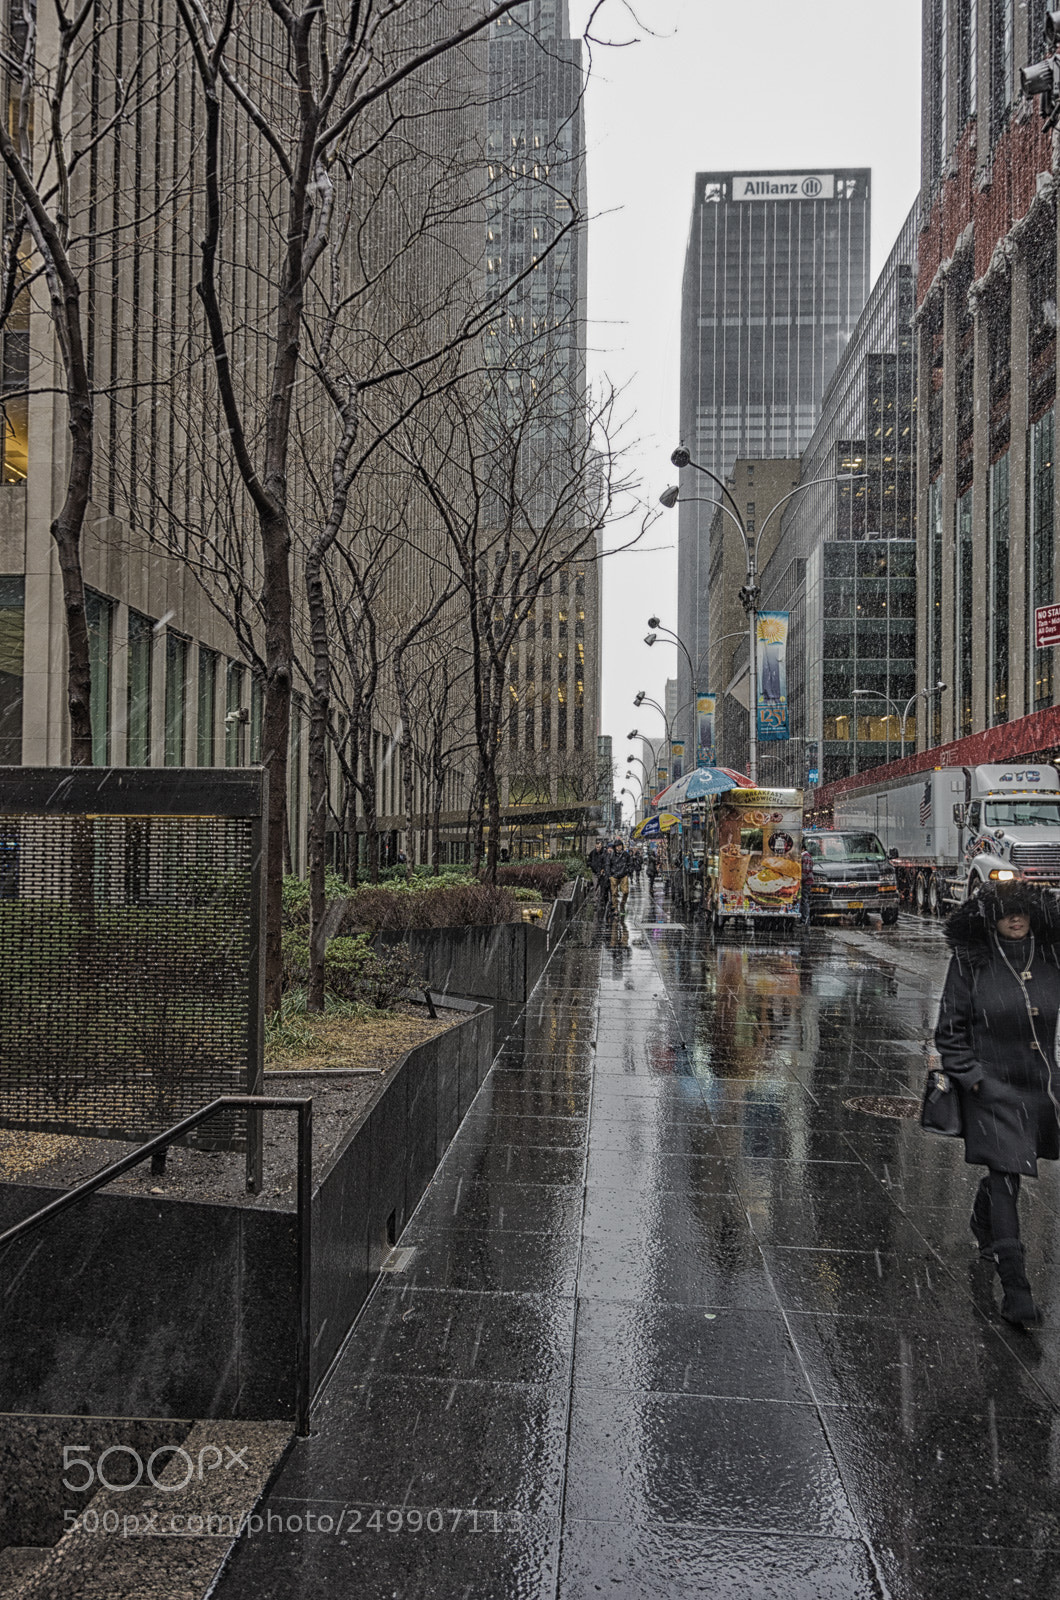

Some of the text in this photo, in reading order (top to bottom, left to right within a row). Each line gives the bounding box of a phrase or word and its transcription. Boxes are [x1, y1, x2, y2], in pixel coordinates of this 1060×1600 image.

[744, 181, 798, 195] Allianz
[1038, 611, 1047, 619] NO
[760, 709, 785, 727] 1251
[744, 796, 784, 804] SANDWICHES
